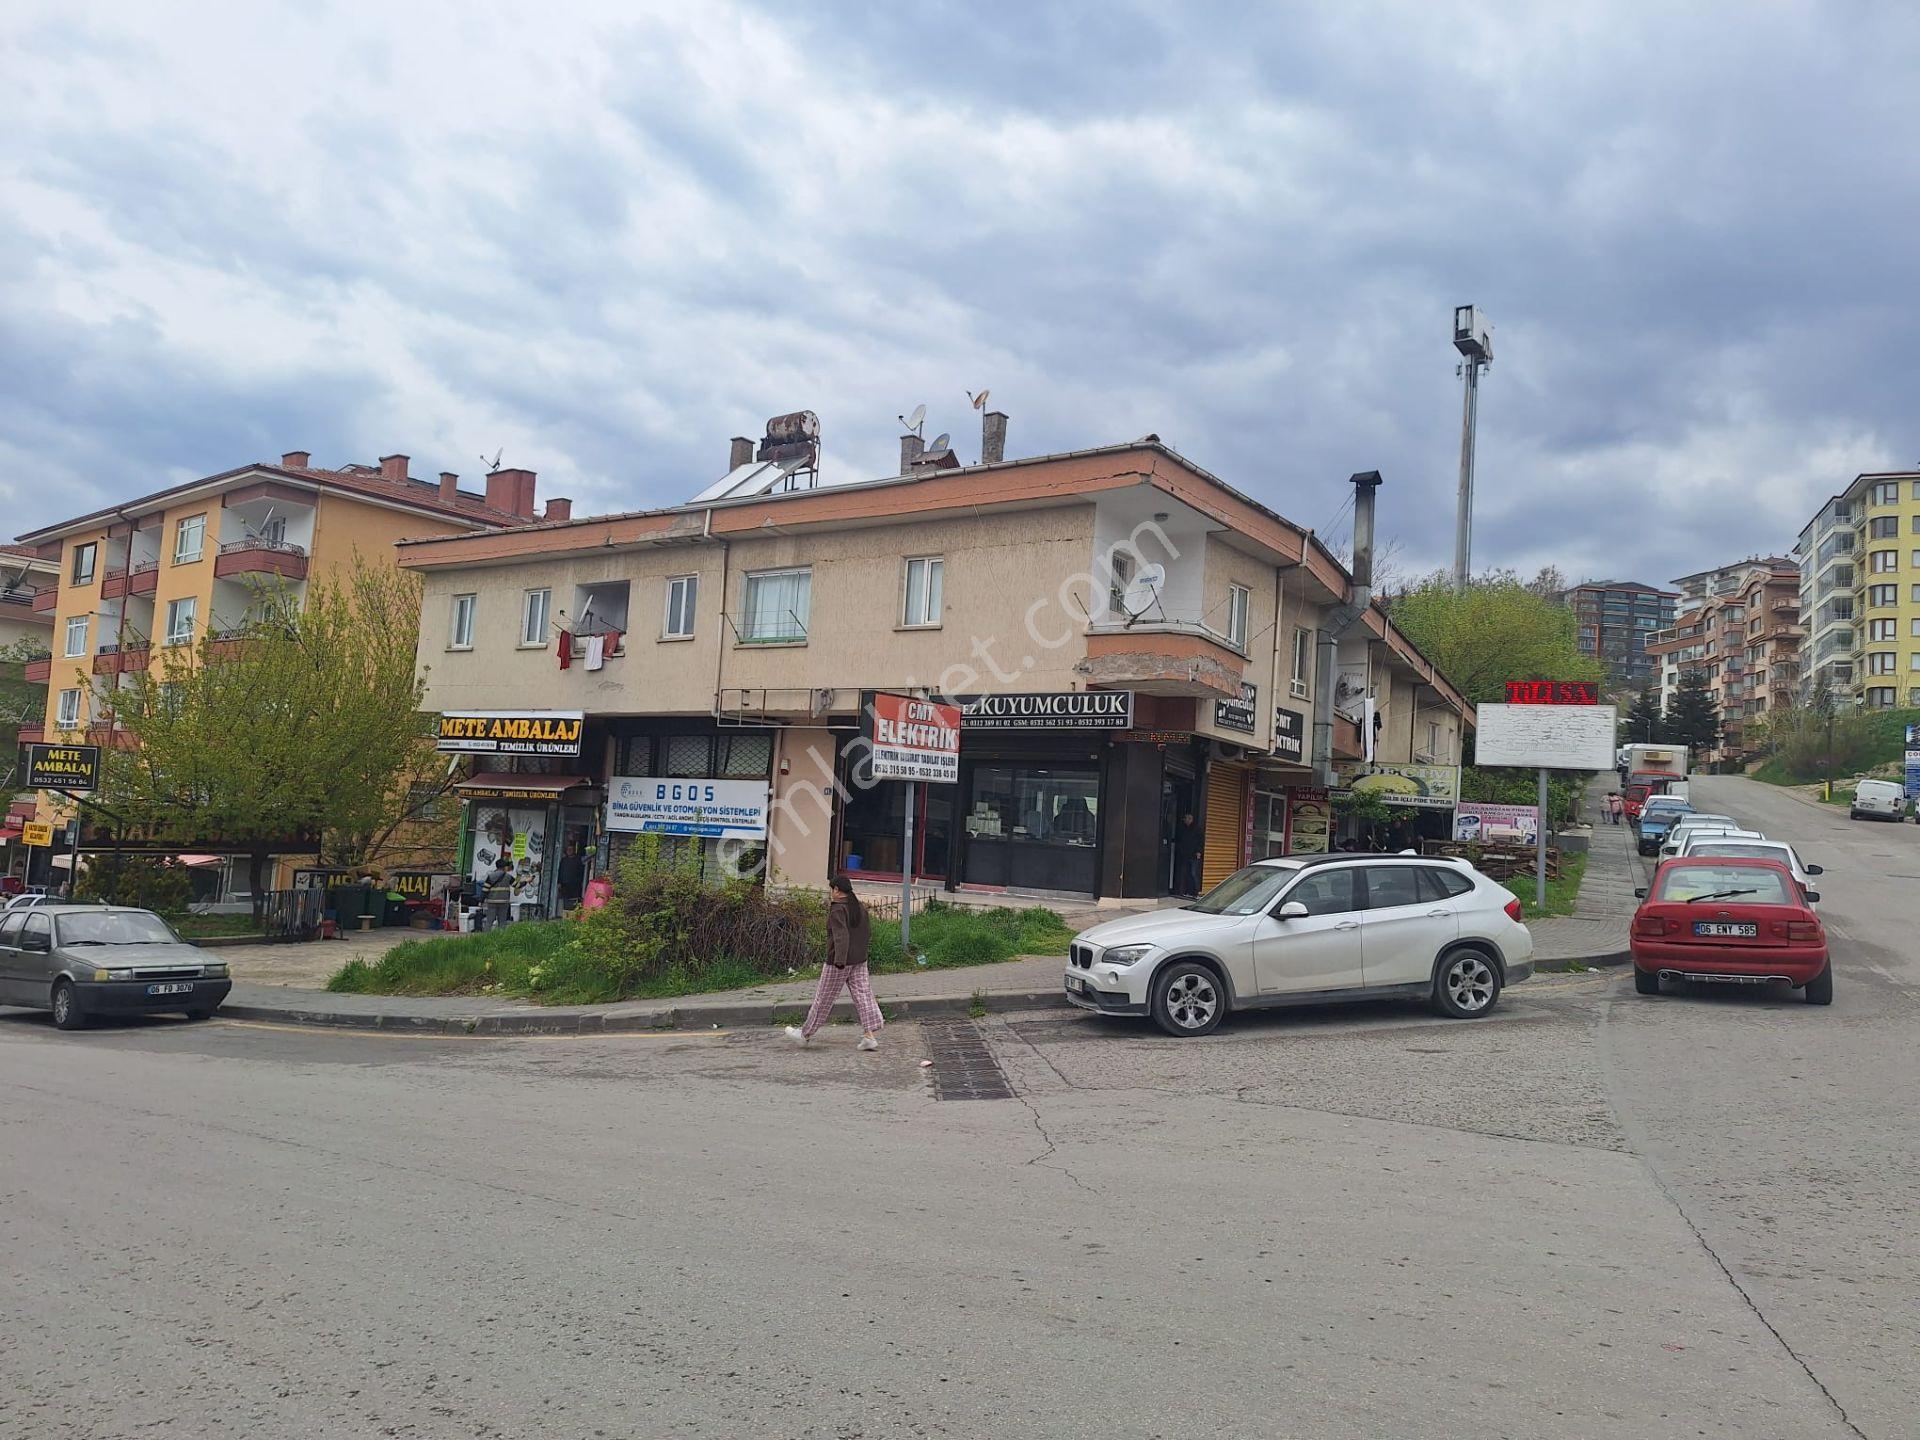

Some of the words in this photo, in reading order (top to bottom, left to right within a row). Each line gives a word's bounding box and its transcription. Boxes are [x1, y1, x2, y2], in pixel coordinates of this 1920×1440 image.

[908, 702, 934, 722] CMT
[980, 694, 1126, 715] KUYUMCULUK
[440, 718, 487, 737] METE
[489, 719, 581, 741] AMBALAJ
[878, 718, 957, 750] ELEKTRİK
[500, 742, 535, 752] TEMİZLİK
[536, 741, 578, 753] ÜRÜNLERİ
[48, 749, 82, 761] METE
[34, 761, 92, 776] AMBALAJ
[612, 801, 629, 810] BİNA
[629, 802, 662, 812] GÜVENLİK
[663, 805, 672, 813] VE
[673, 805, 718, 815] OTOMASYON
[719, 804, 761, 816] SİSTEMLERİ
[1700, 924, 1712, 933] 06
[1717, 925, 1733, 934] ENY
[1739, 925, 1756, 935] 585
